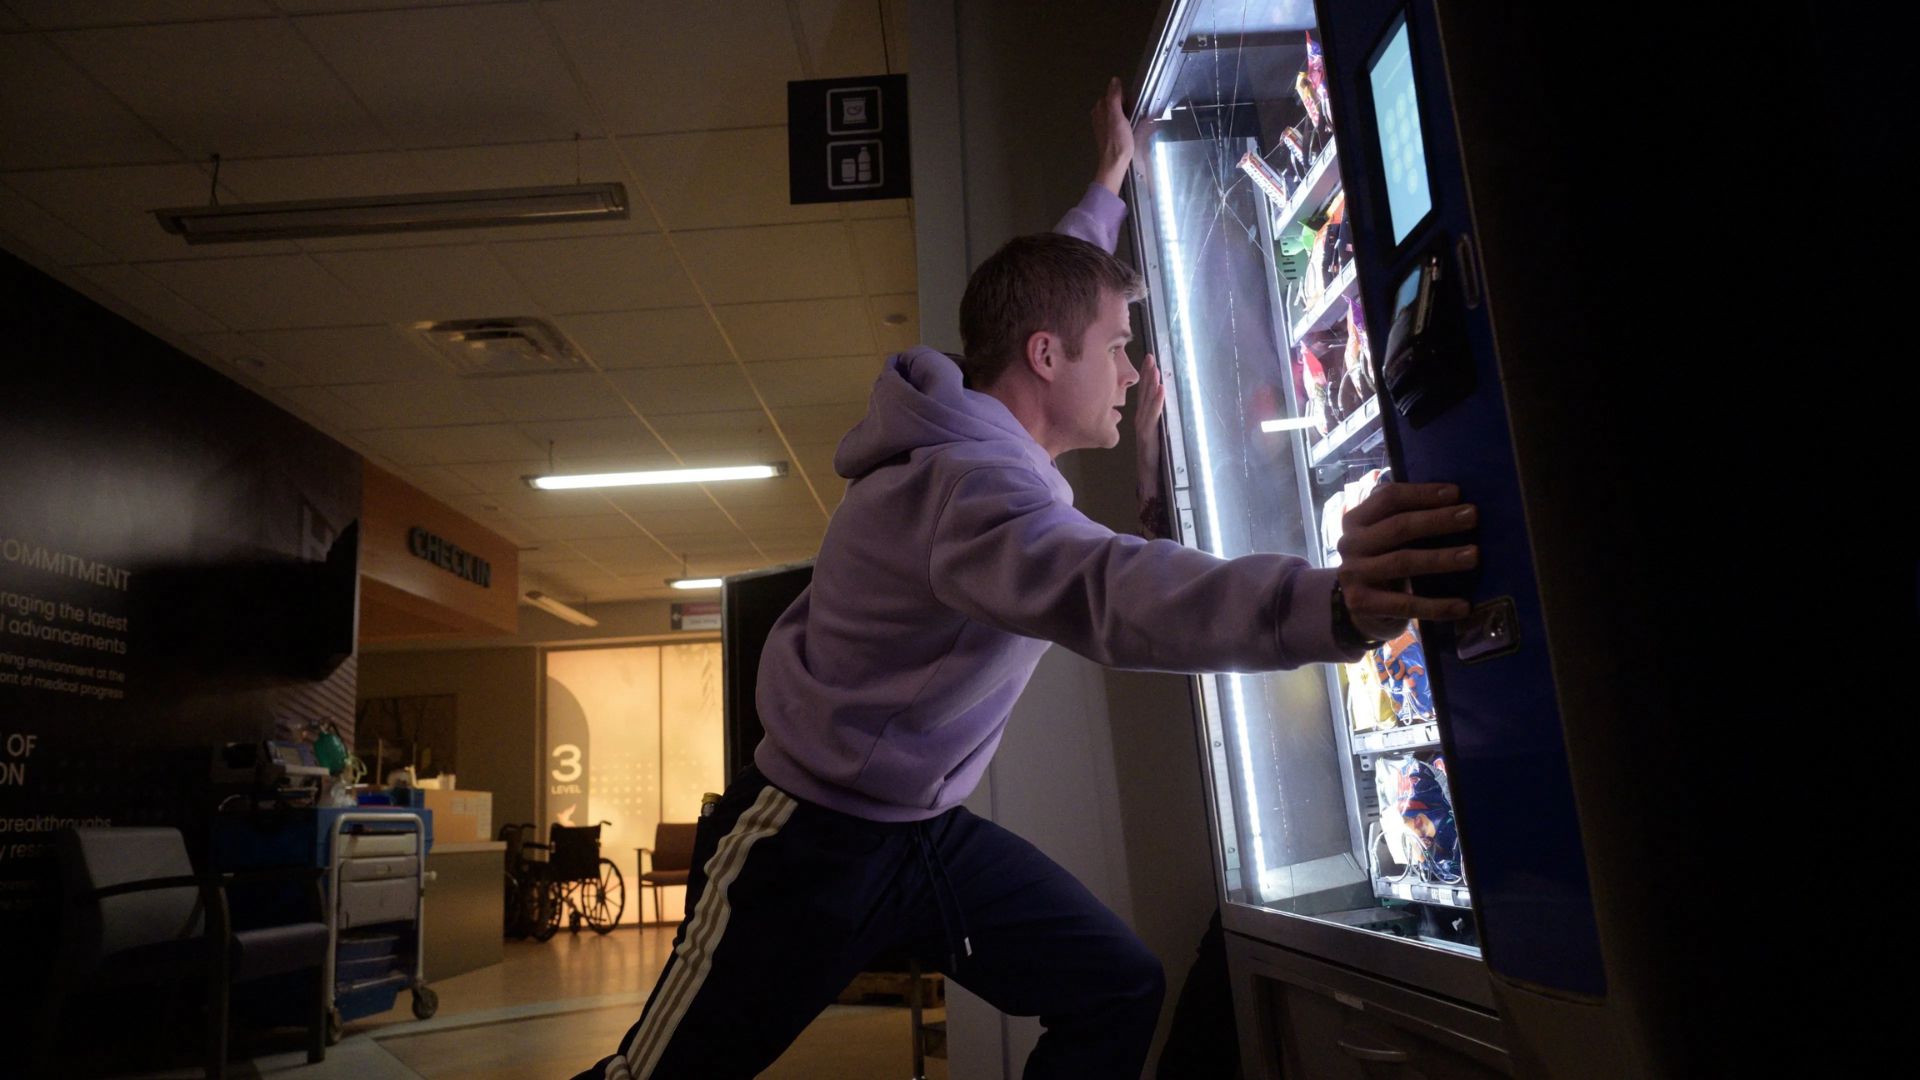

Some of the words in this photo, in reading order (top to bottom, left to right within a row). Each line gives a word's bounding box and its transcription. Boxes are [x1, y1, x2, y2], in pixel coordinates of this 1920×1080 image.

[2, 539, 131, 591] OMMITMENT
[59, 603, 84, 622] the
[88, 608, 128, 632] latest
[8, 618, 128, 655] advancements
[27, 657, 96, 678] environment
[34, 677, 79, 693] medical
[80, 683, 124, 700] progress
[6, 733, 38, 758] OF
[551, 744, 583, 783] 3
[551, 784, 582, 795] LEVEL
